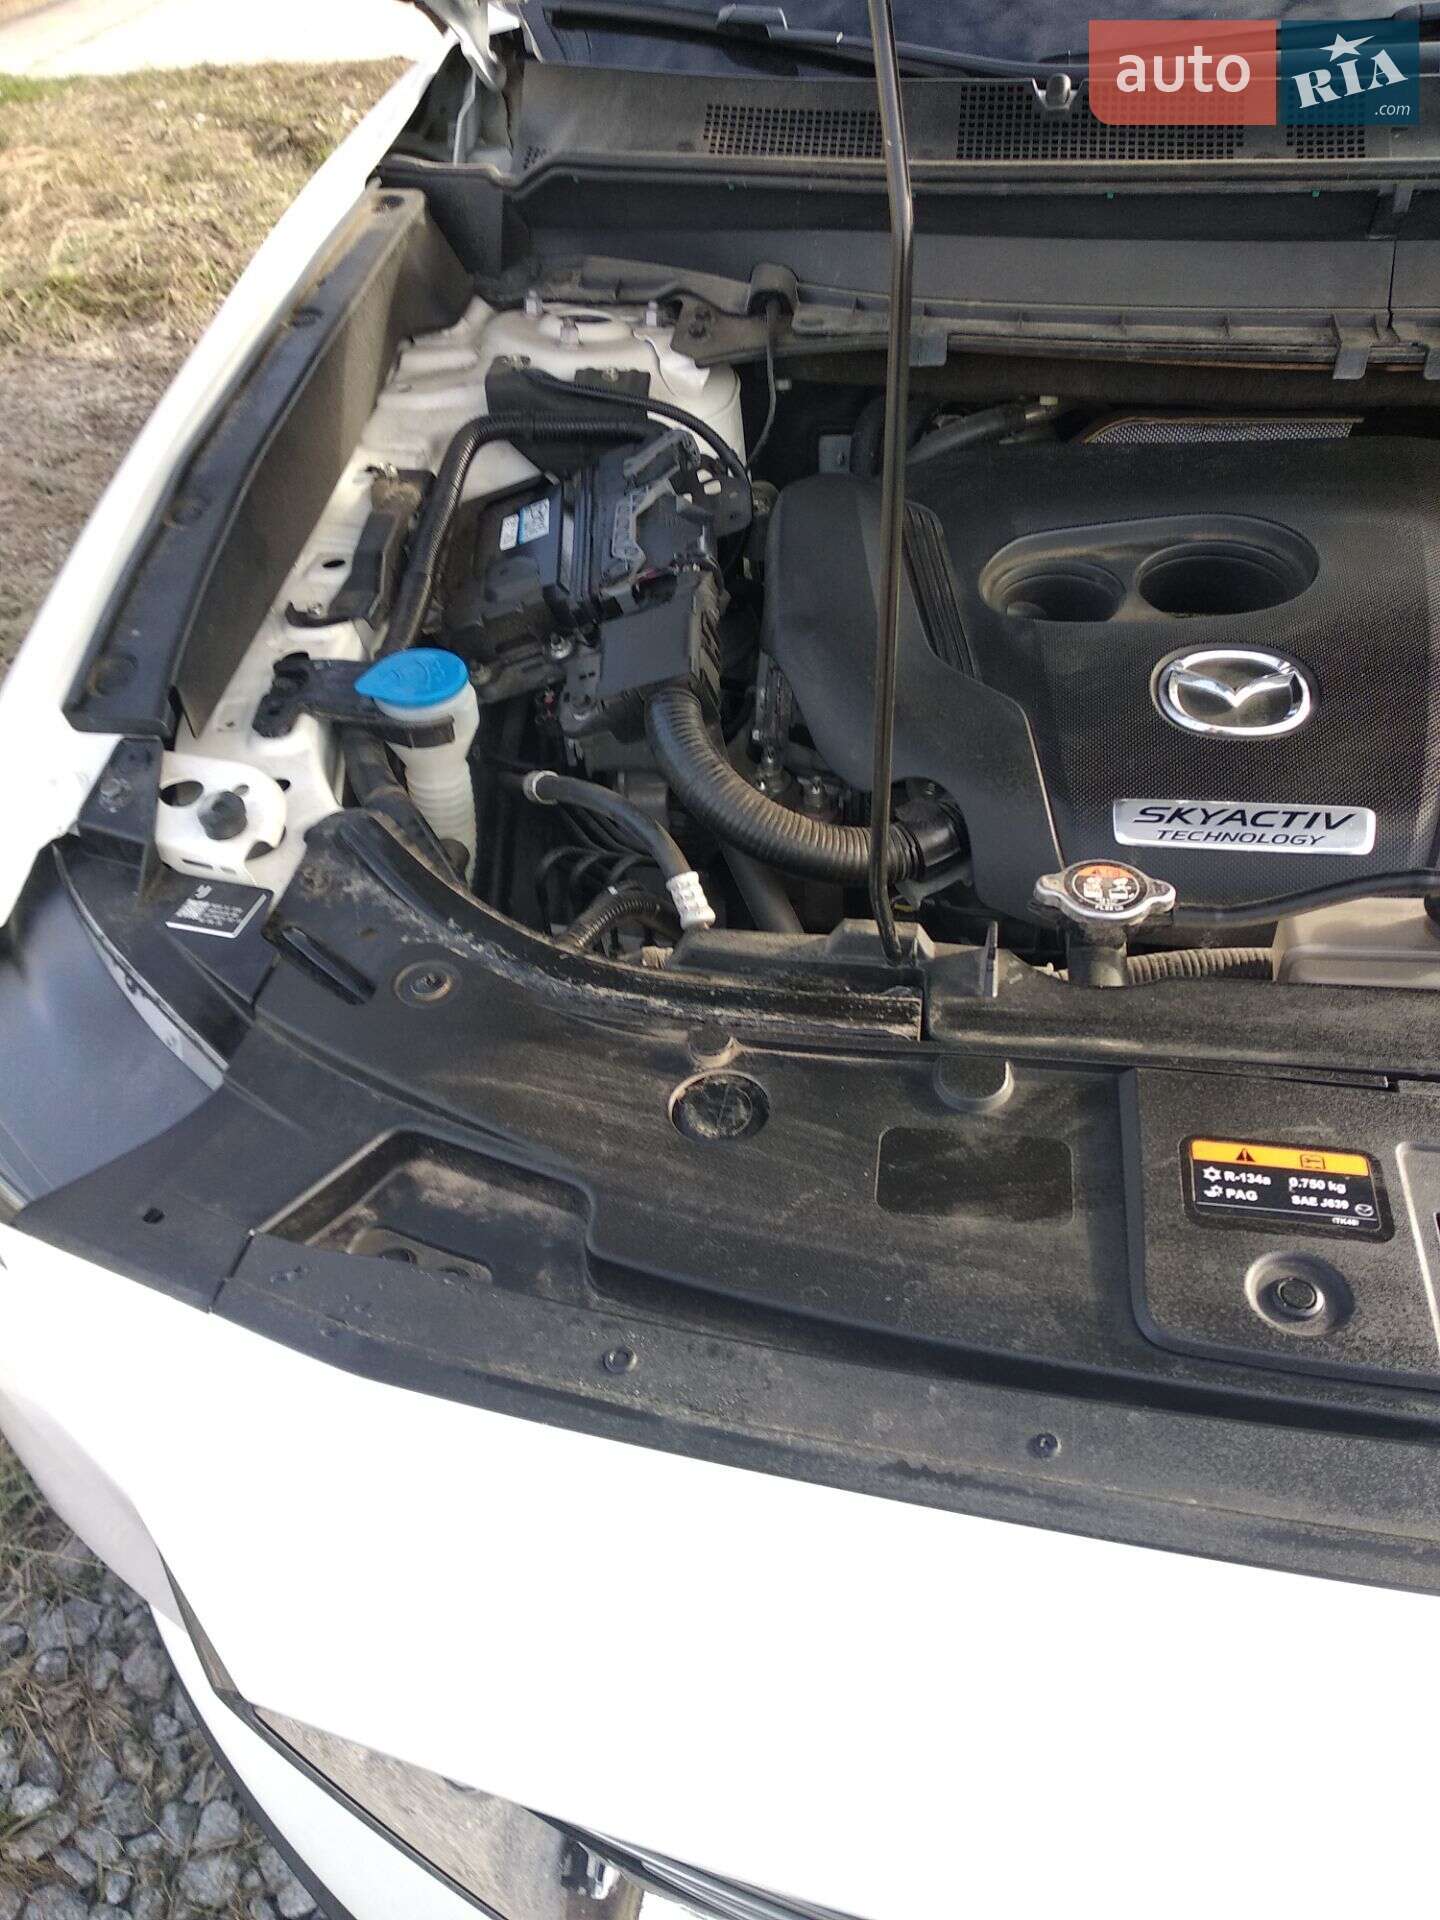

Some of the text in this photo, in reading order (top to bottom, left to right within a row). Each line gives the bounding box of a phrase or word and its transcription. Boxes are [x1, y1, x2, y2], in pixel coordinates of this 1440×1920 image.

[1133, 805, 1356, 831] SKYACTIV
[1156, 829, 1327, 846] TECHNOLOGY
[1223, 1170, 1347, 1195] R-134a 0.750 kg
[1225, 1187, 1350, 1210] PAG SAE J639
